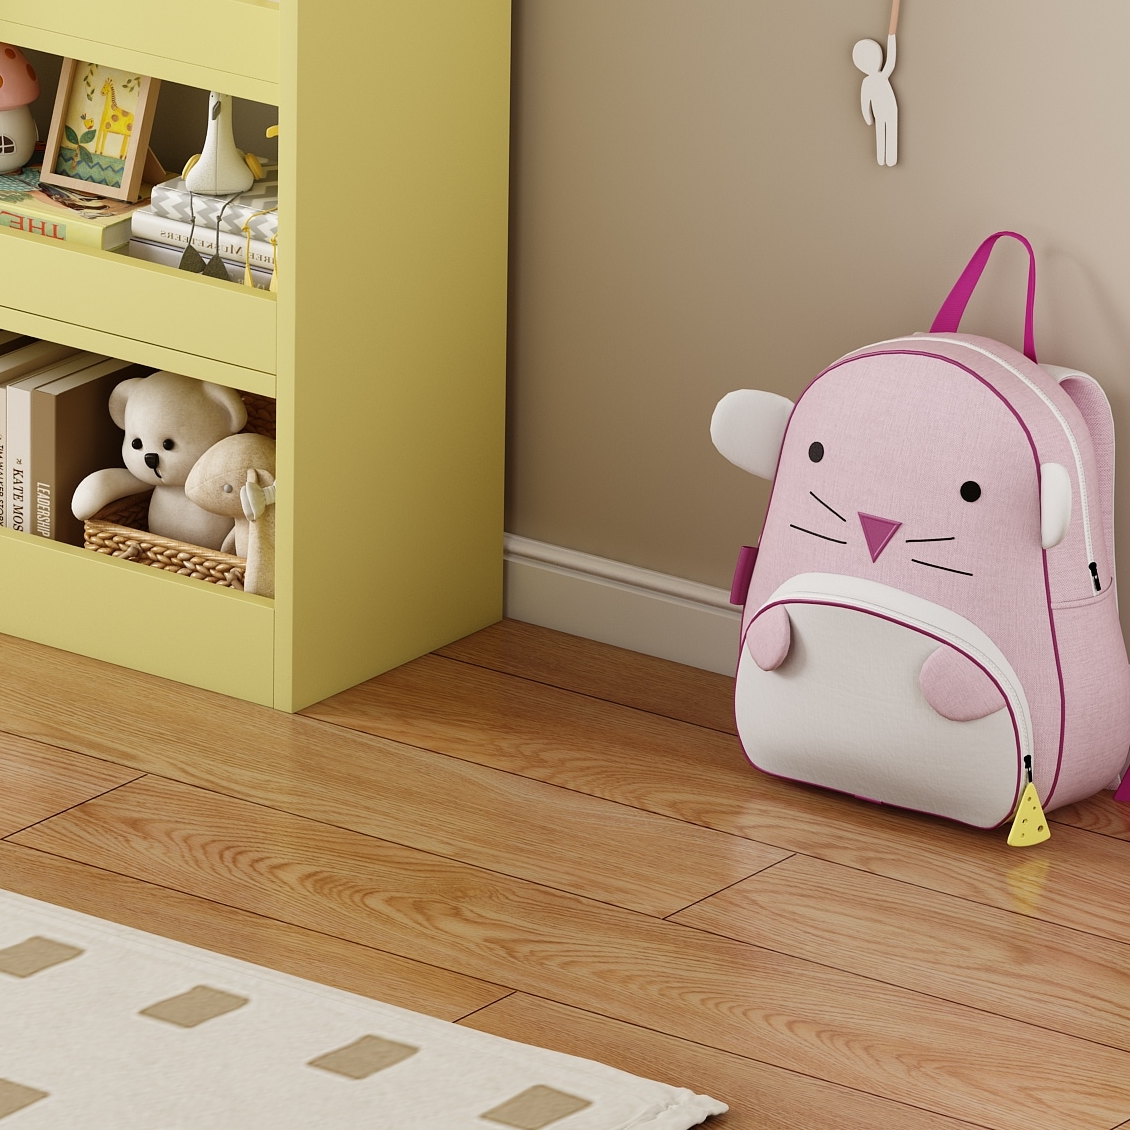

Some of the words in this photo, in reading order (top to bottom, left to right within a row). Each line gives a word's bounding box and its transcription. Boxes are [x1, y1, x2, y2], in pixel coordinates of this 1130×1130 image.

[0, 210, 64, 241] THE
[13, 468, 24, 502] KATE
[13, 503, 24, 532] MOS
[36, 482, 50, 537] LEADERSHIP
